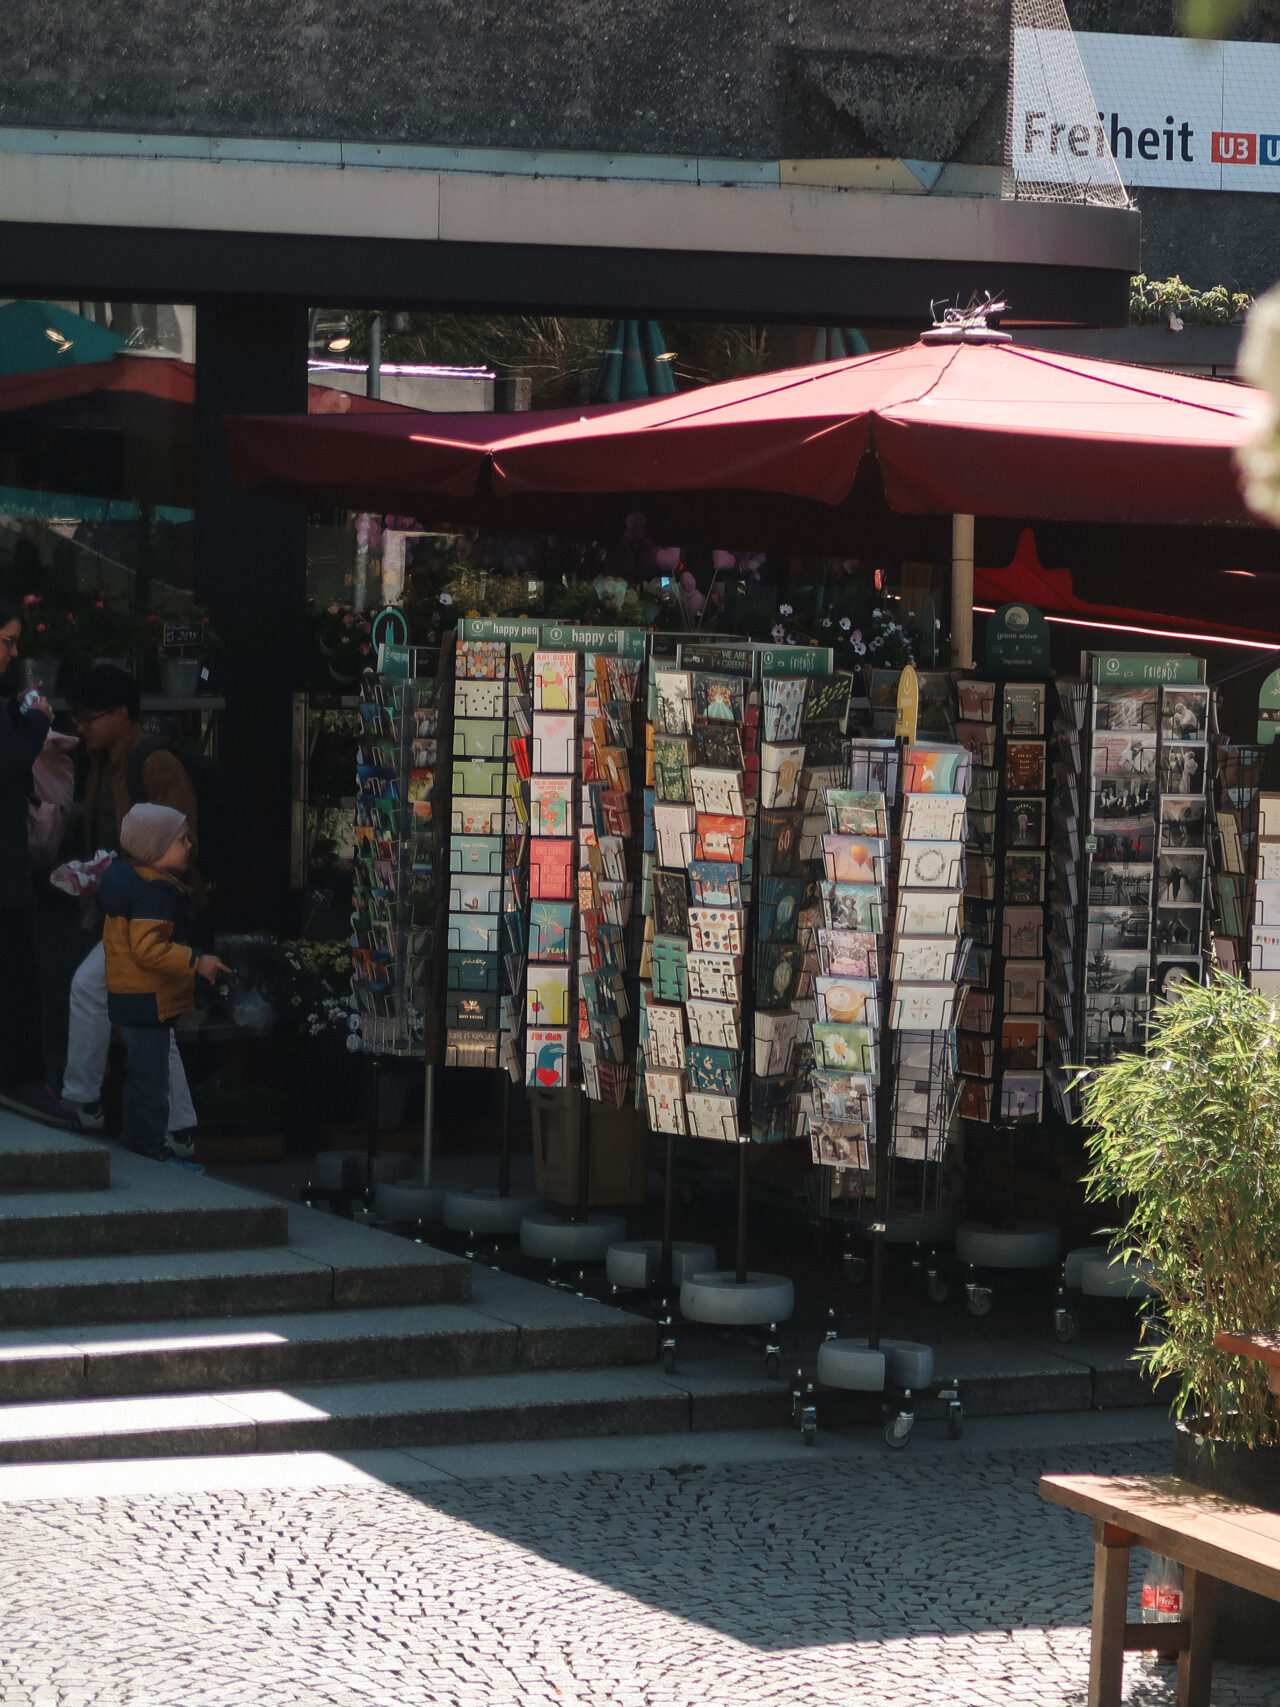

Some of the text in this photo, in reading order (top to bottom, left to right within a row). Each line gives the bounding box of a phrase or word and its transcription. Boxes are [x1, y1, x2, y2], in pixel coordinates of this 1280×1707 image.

[1024, 110, 1194, 163] Freiheit
[1218, 136, 1250, 160] U3
[493, 623, 520, 637] happy
[572, 629, 604, 645] happy
[721, 650, 747, 660] WE ARE
[1143, 664, 1178, 681] FRIENDS
[777, 830, 790, 852] 60
